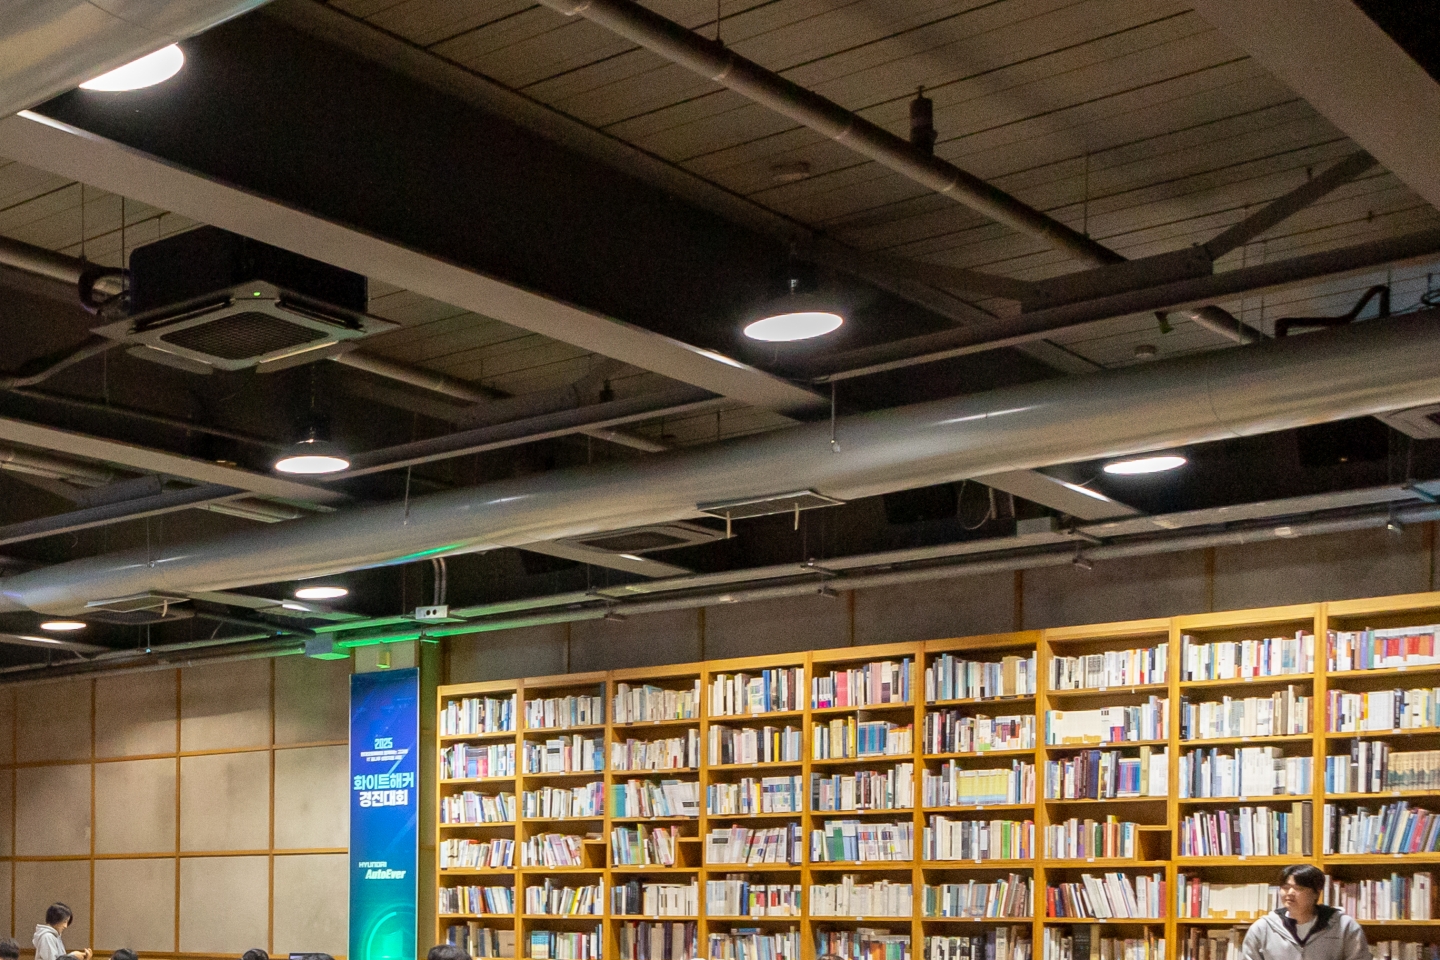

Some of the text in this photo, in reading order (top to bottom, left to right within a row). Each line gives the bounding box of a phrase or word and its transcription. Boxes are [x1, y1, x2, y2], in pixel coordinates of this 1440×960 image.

[374, 737, 393, 749] 2025
[354, 772, 414, 791] 화이트해커
[359, 789, 408, 808] 경진대회
[365, 868, 406, 880] AutoEver
